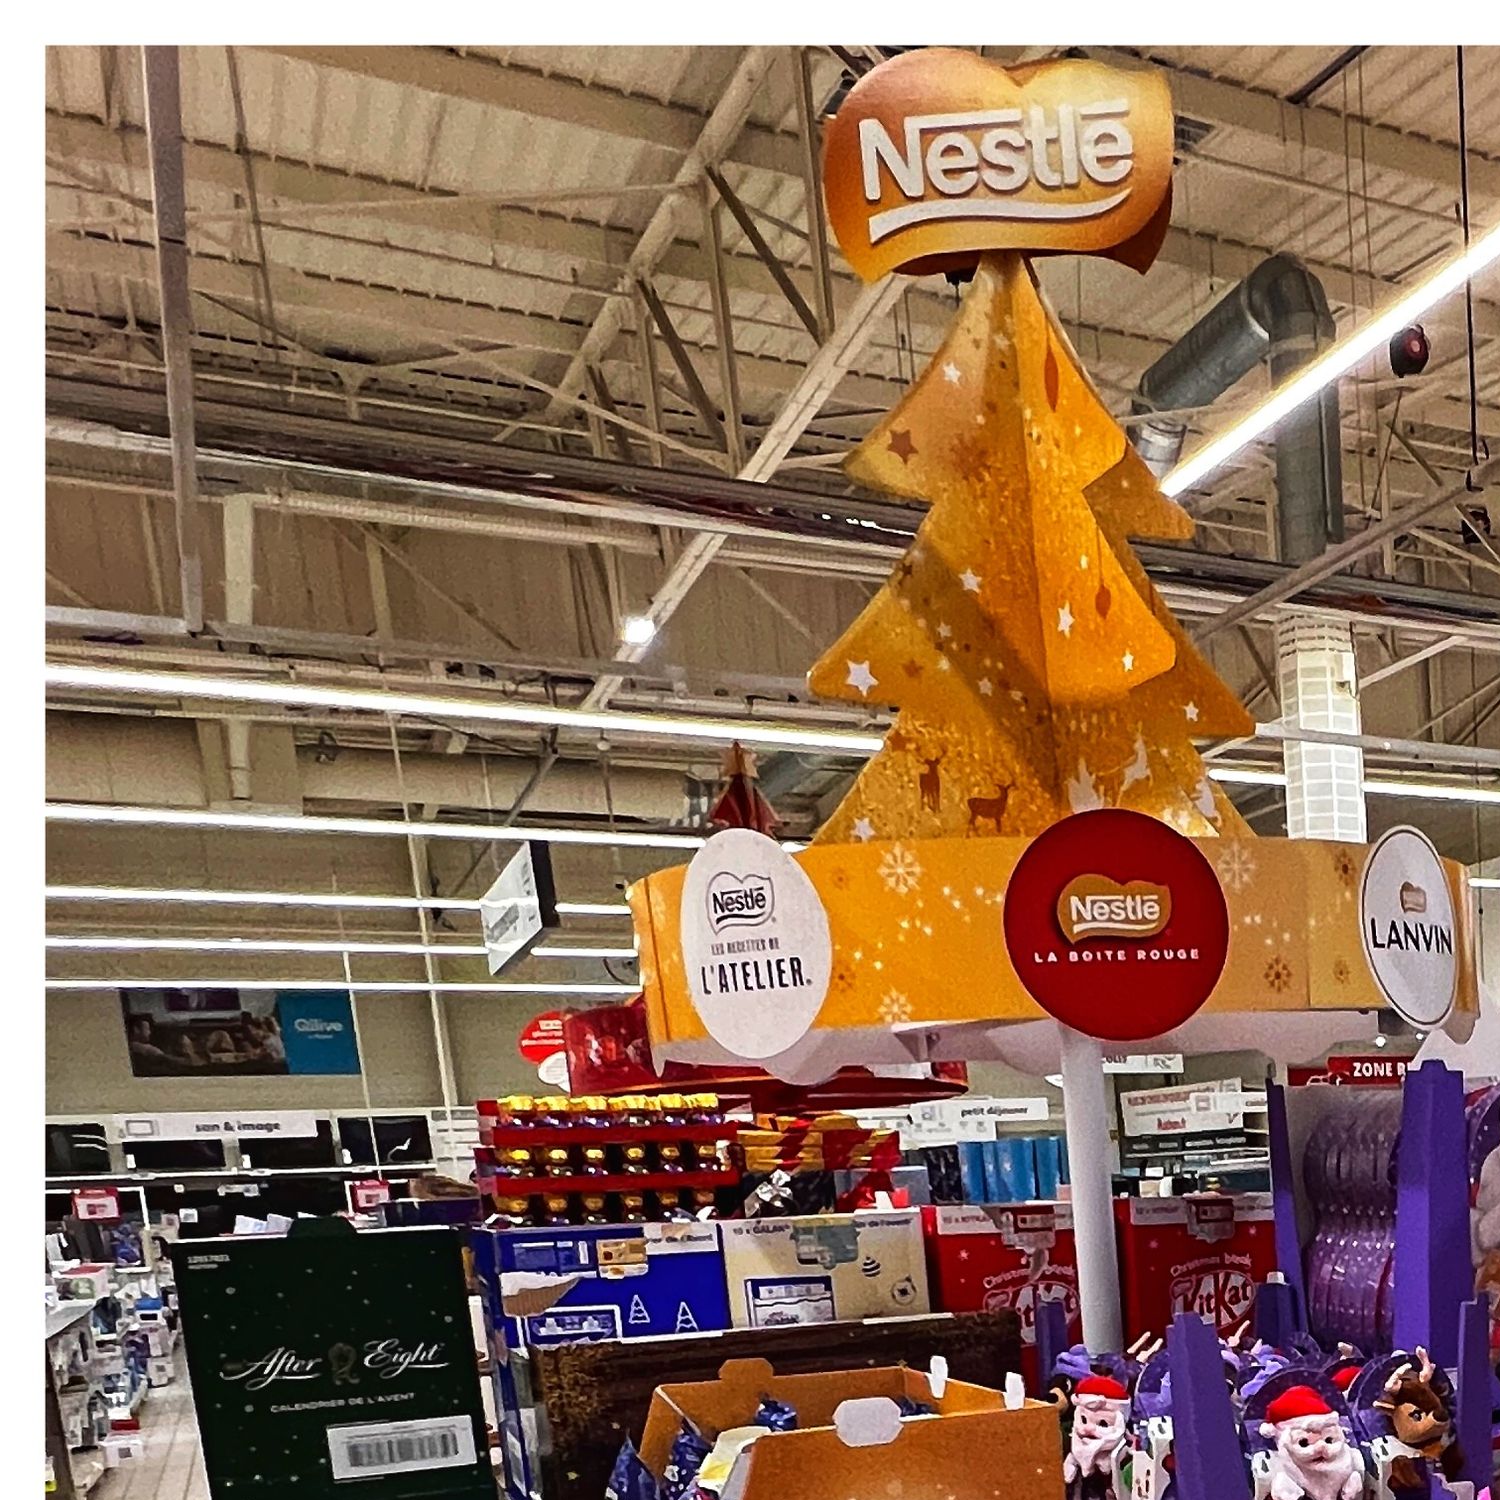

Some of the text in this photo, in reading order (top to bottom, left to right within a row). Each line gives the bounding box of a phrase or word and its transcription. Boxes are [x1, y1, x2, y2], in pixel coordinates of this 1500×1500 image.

[858, 99, 1134, 200] Nestlé
[712, 886, 767, 914] Nestlé
[1070, 894, 1160, 922] Nestlé
[1370, 917, 1453, 956] LANVIN
[1034, 951, 1058, 963] LA
[1137, 949, 1199, 961] ROUGE
[1353, 1061, 1393, 1077] ZONE
[219, 1338, 449, 1391] After Eight
